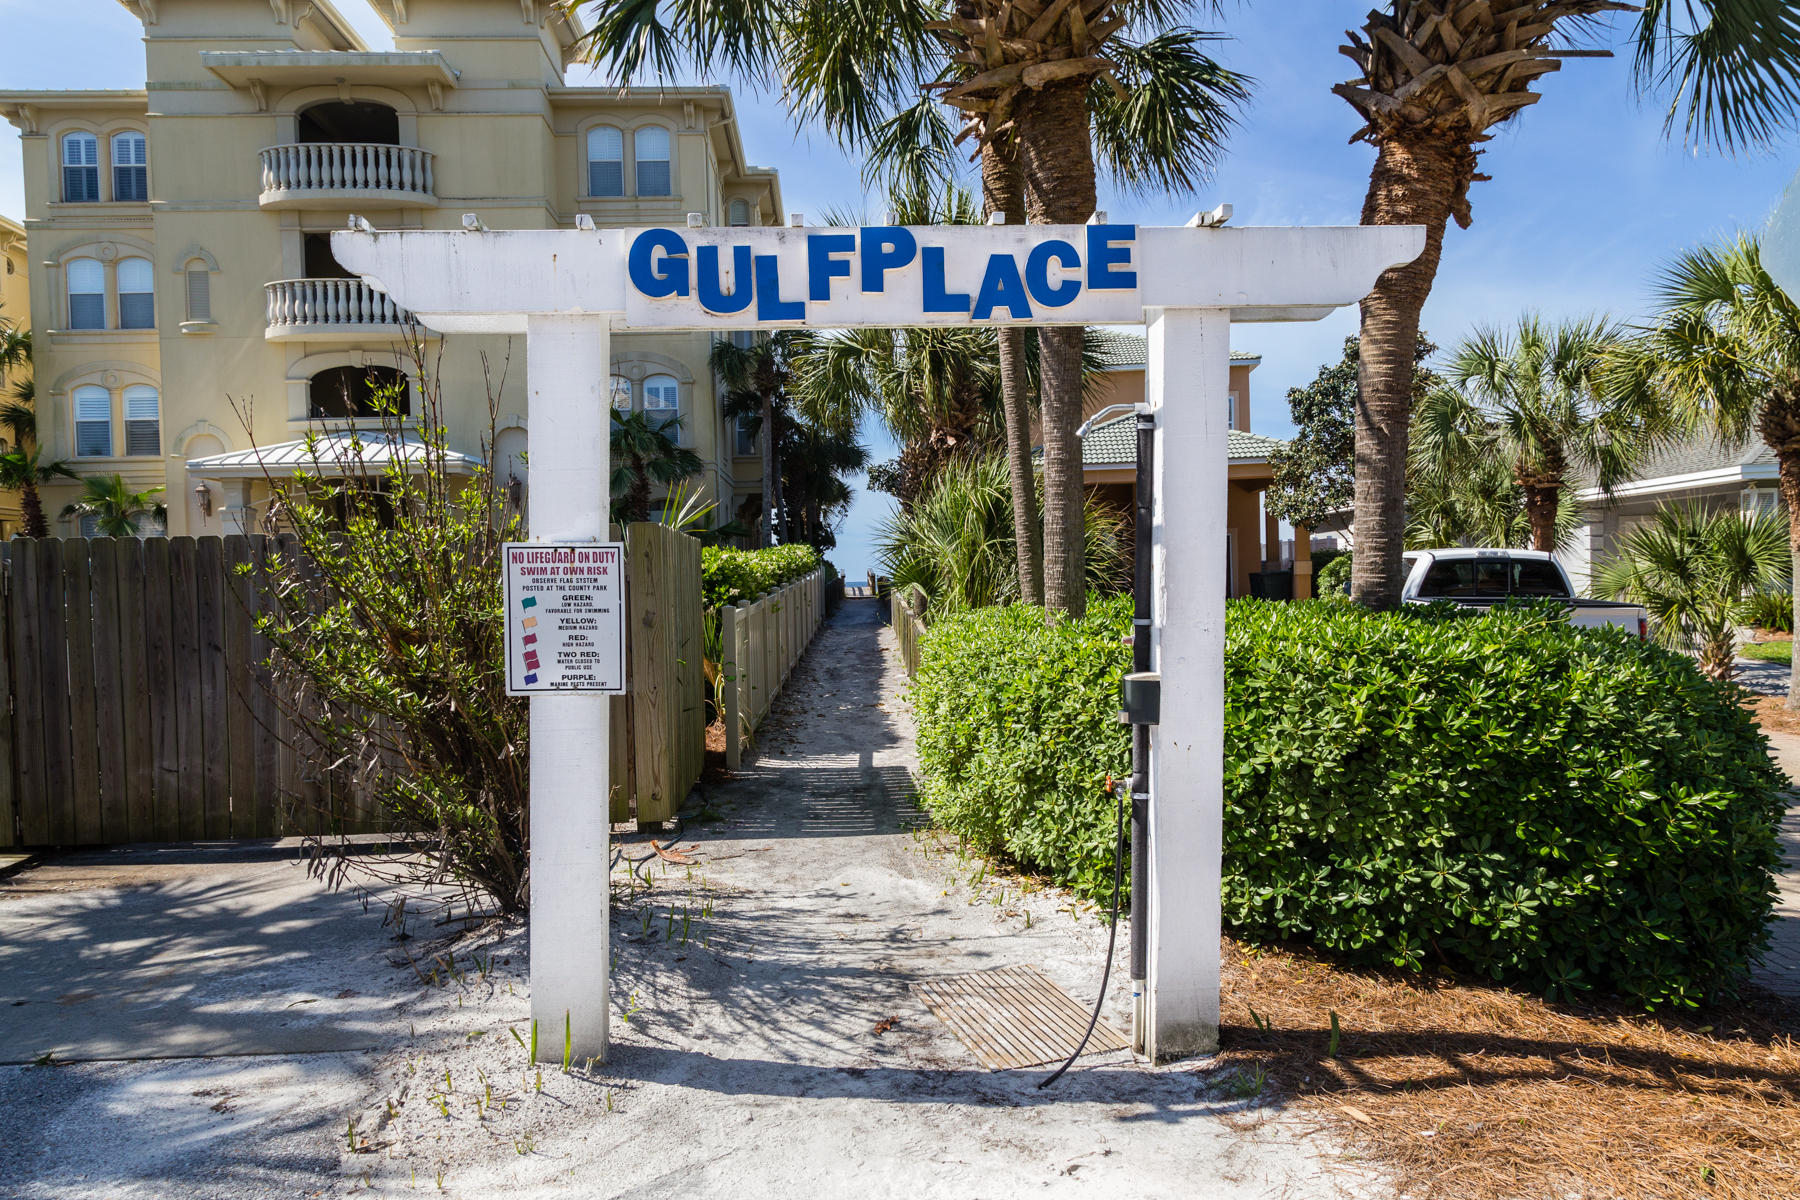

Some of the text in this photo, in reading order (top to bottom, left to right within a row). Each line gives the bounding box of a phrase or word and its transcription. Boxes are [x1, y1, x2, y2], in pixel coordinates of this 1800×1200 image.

[512, 552, 616, 564] NO LIFEGUARD ON DUTY
[520, 567, 608, 575] SWIM AT OWN RISK
